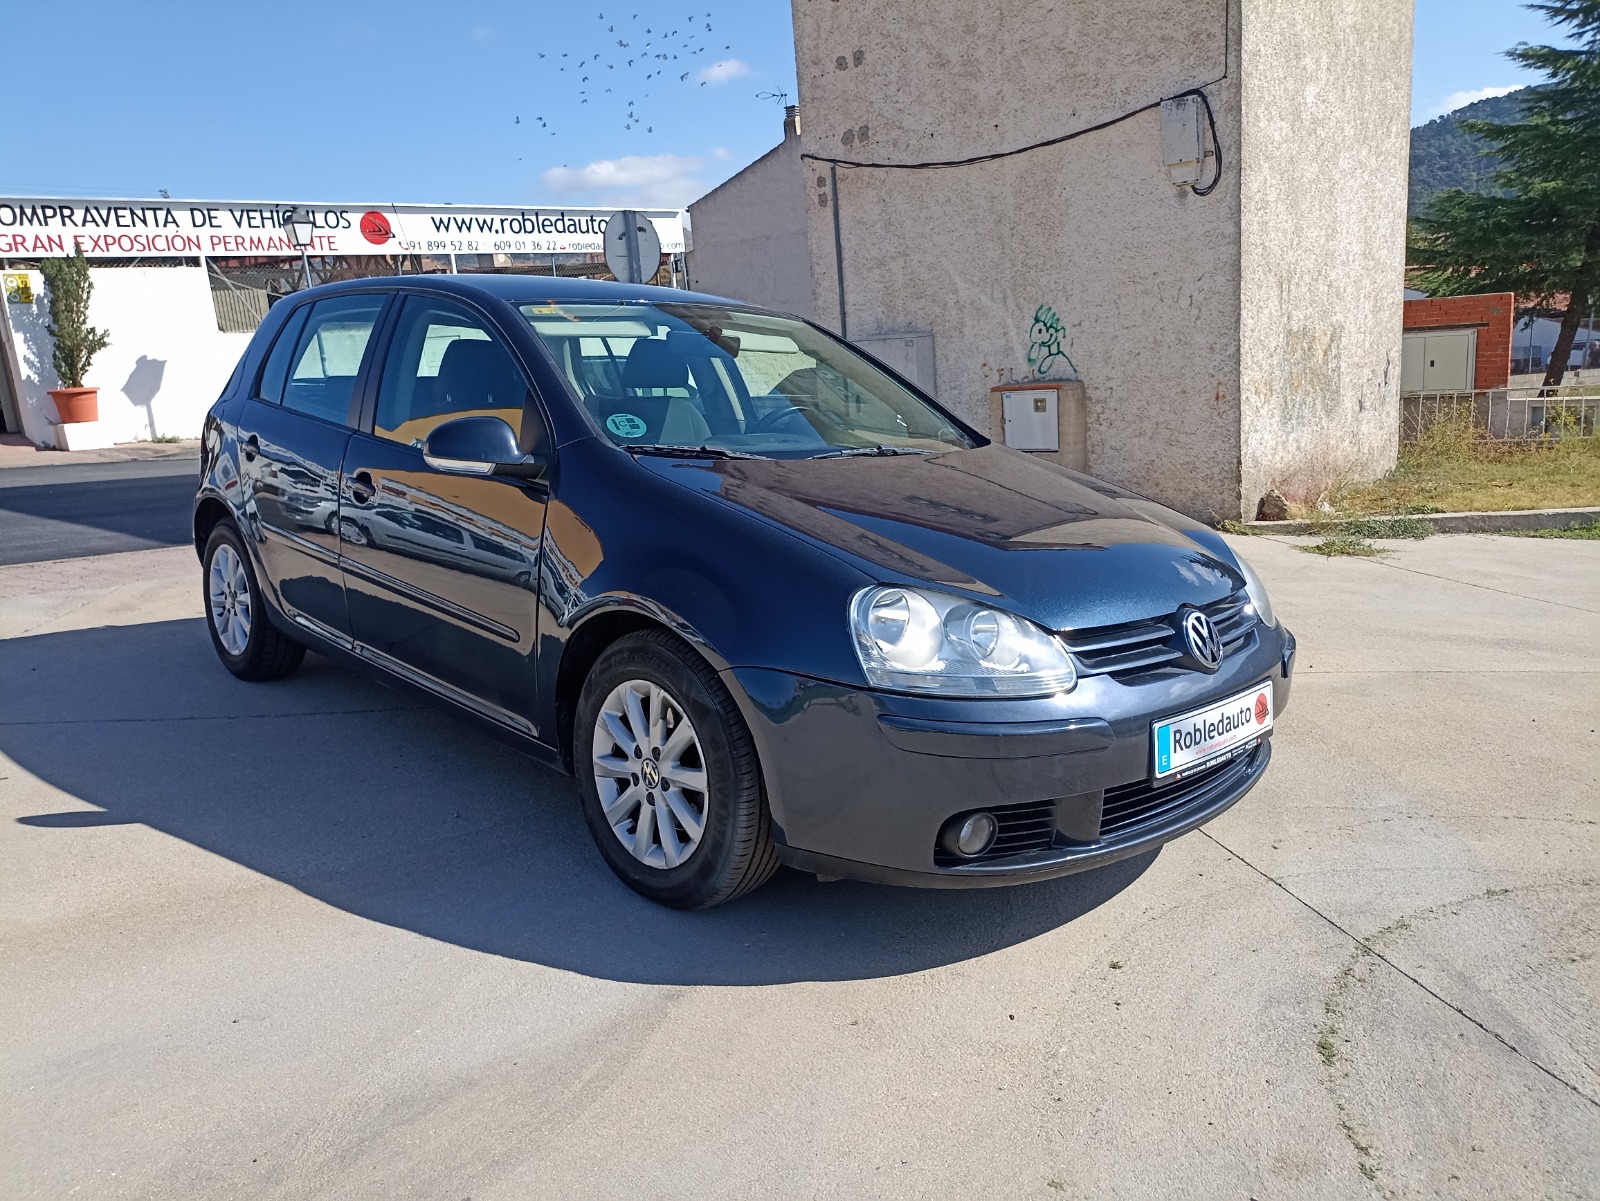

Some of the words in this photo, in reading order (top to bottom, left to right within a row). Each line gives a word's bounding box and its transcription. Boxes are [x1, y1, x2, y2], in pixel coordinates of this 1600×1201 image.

[189, 207, 222, 228] DE
[229, 204, 351, 229] VEHÍCLOS
[431, 211, 653, 235] www.robledauto
[0, 234, 64, 253] GRAN
[73, 230, 202, 252] EXPOSICIÓN
[210, 235, 338, 252] PERMANNTE
[409, 240, 422, 251] 91
[427, 240, 446, 252] 899
[450, 240, 463, 252] 52
[467, 240, 480, 252] 82
[493, 240, 512, 251] 609
[514, 240, 526, 251] 01
[531, 240, 542, 251] 36
[546, 240, 557, 251] 22
[1173, 706, 1252, 754] Robledauto
[1161, 754, 1168, 766] E
